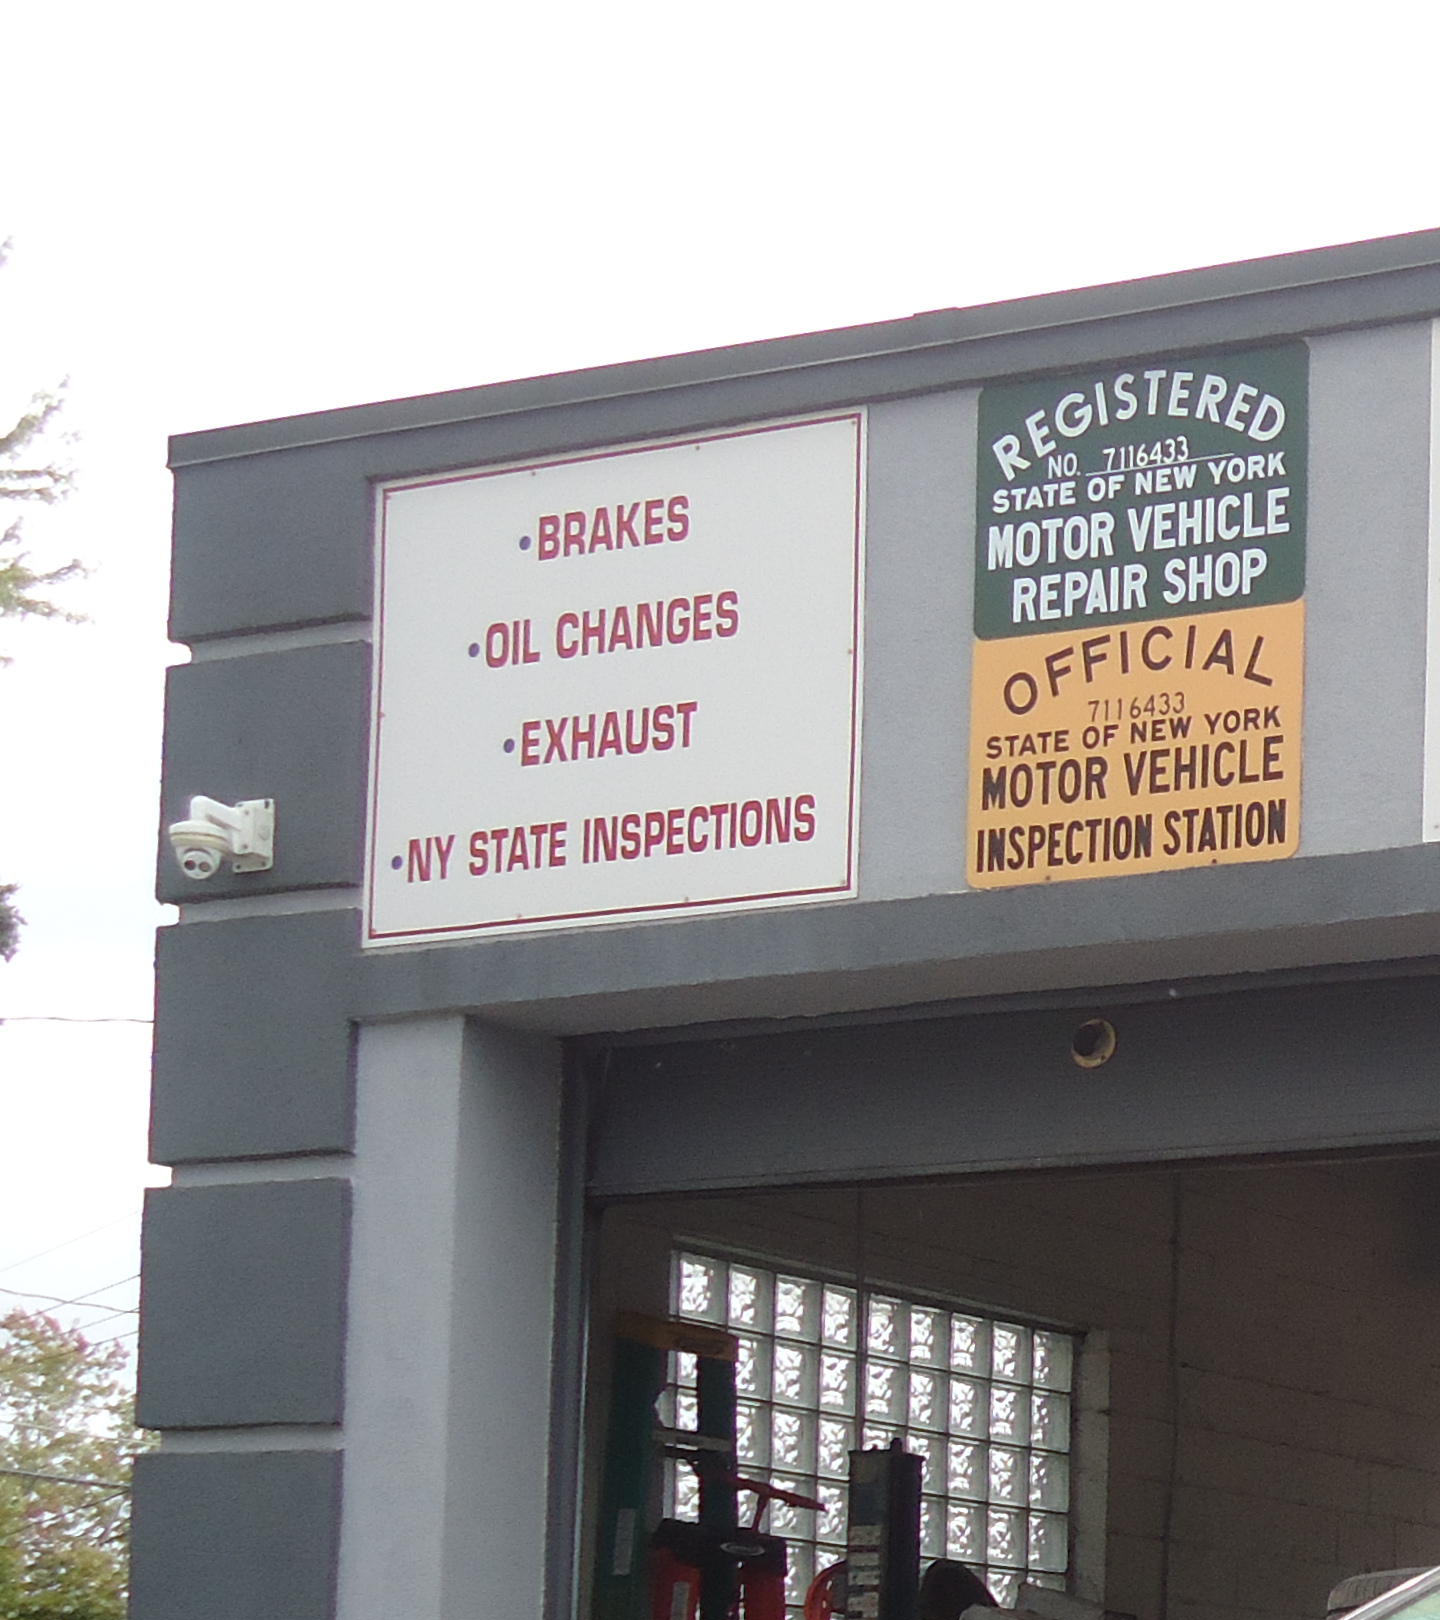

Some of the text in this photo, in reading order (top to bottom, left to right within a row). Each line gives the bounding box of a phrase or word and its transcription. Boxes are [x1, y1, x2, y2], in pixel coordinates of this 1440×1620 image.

[992, 369, 1286, 481] REGISTERED
[1047, 435, 1189, 480] NO. 7116433
[992, 452, 1286, 514] STATE OF NEW YORK
[538, 495, 690, 561] BRAKES
[987, 486, 1290, 571] MOTOR VEHICLE
[1012, 547, 1268, 623] REPAIR SHOP
[485, 590, 739, 668] OIL CHANGES
[1003, 623, 1274, 716] OFFICIAL
[1087, 691, 1185, 723] 7116433
[521, 701, 698, 767] EXHAUST
[986, 705, 1282, 761] STATE OF NEW YORK
[981, 734, 1284, 812] MOTOR VEHICLE
[407, 794, 815, 883] NY STATE INSPECTIONS
[976, 798, 1287, 873] INSPECTION STATION
